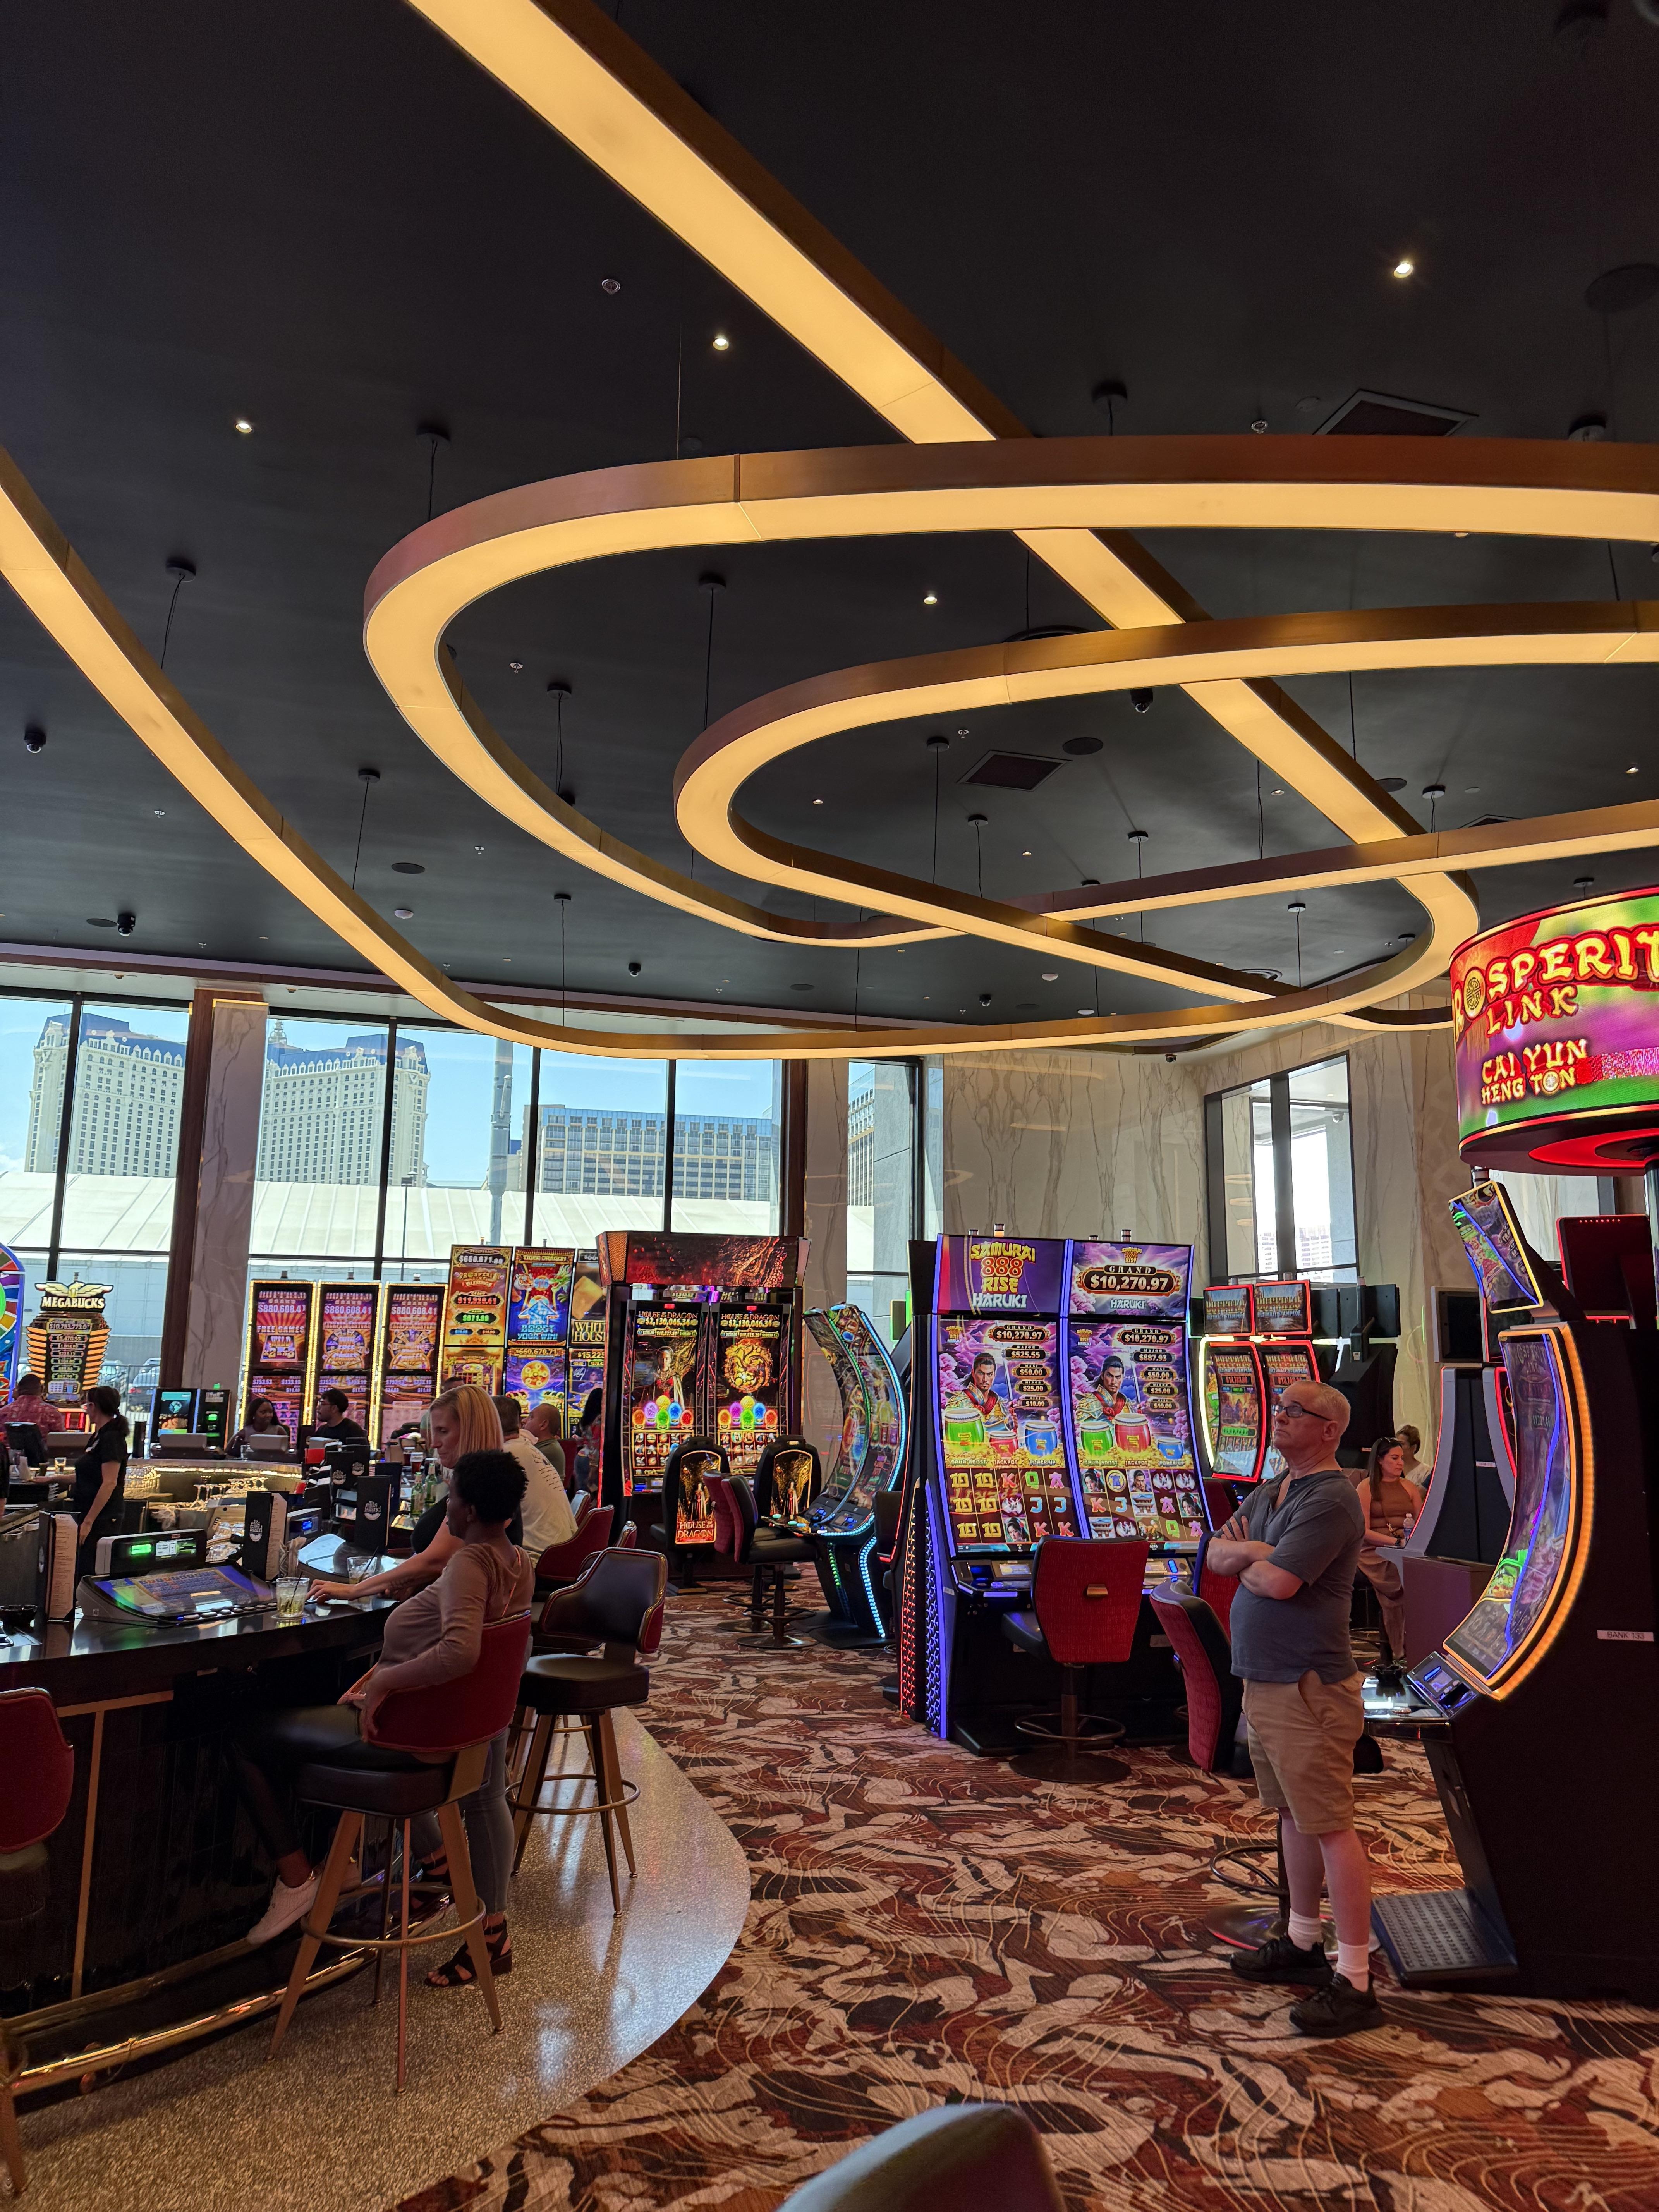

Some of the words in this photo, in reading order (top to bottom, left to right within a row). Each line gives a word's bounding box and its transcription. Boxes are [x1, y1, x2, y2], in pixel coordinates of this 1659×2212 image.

[1454, 930, 1659, 1043] ROSPERIT
[1487, 986, 1578, 1035] LINK
[1482, 1052, 1515, 1084] CAI
[1523, 1038, 1587, 1072] YUN
[1481, 1077, 1524, 1105] HENG
[970, 1241, 1036, 1262] SAMURAI
[981, 1257, 1024, 1278] 888
[982, 1277, 1018, 1293] RISE
[1091, 1274, 1168, 1291] $10,270.97
[42, 1297, 105, 1309] MEGABUCKS
[972, 1293, 1027, 1309] HARUKI
[1110, 1299, 1145, 1309] HARUKI
[521, 1324, 555, 1333] BOOST
[574, 1322, 605, 1332] WHIT
[996, 1330, 1042, 1340] $10,270.97
[574, 1332, 605, 1341] HOUS
[1125, 1333, 1169, 1343] $10,270.97
[950, 1473, 969, 1488] 10
[974, 1473, 994, 1488] 10
[1001, 1473, 1018, 1488] K
[1025, 1471, 1039, 1490] Q
[953, 1498, 973, 1513] 10
[977, 1498, 998, 1513] 10
[1030, 1497, 1042, 1513] J
[1054, 1497, 1067, 1513] J
[1090, 1497, 1106, 1513] K
[1115, 1497, 1127, 1512] J
[677, 1529, 714, 1538] DRAGON
[679, 1521, 706, 1530] HOUSE
[957, 1522, 977, 1538] 10
[982, 1522, 1002, 1538] 10
[1033, 1522, 1050, 1537] K
[1058, 1522, 1074, 1537] K
[1165, 1520, 1180, 1538] Q
